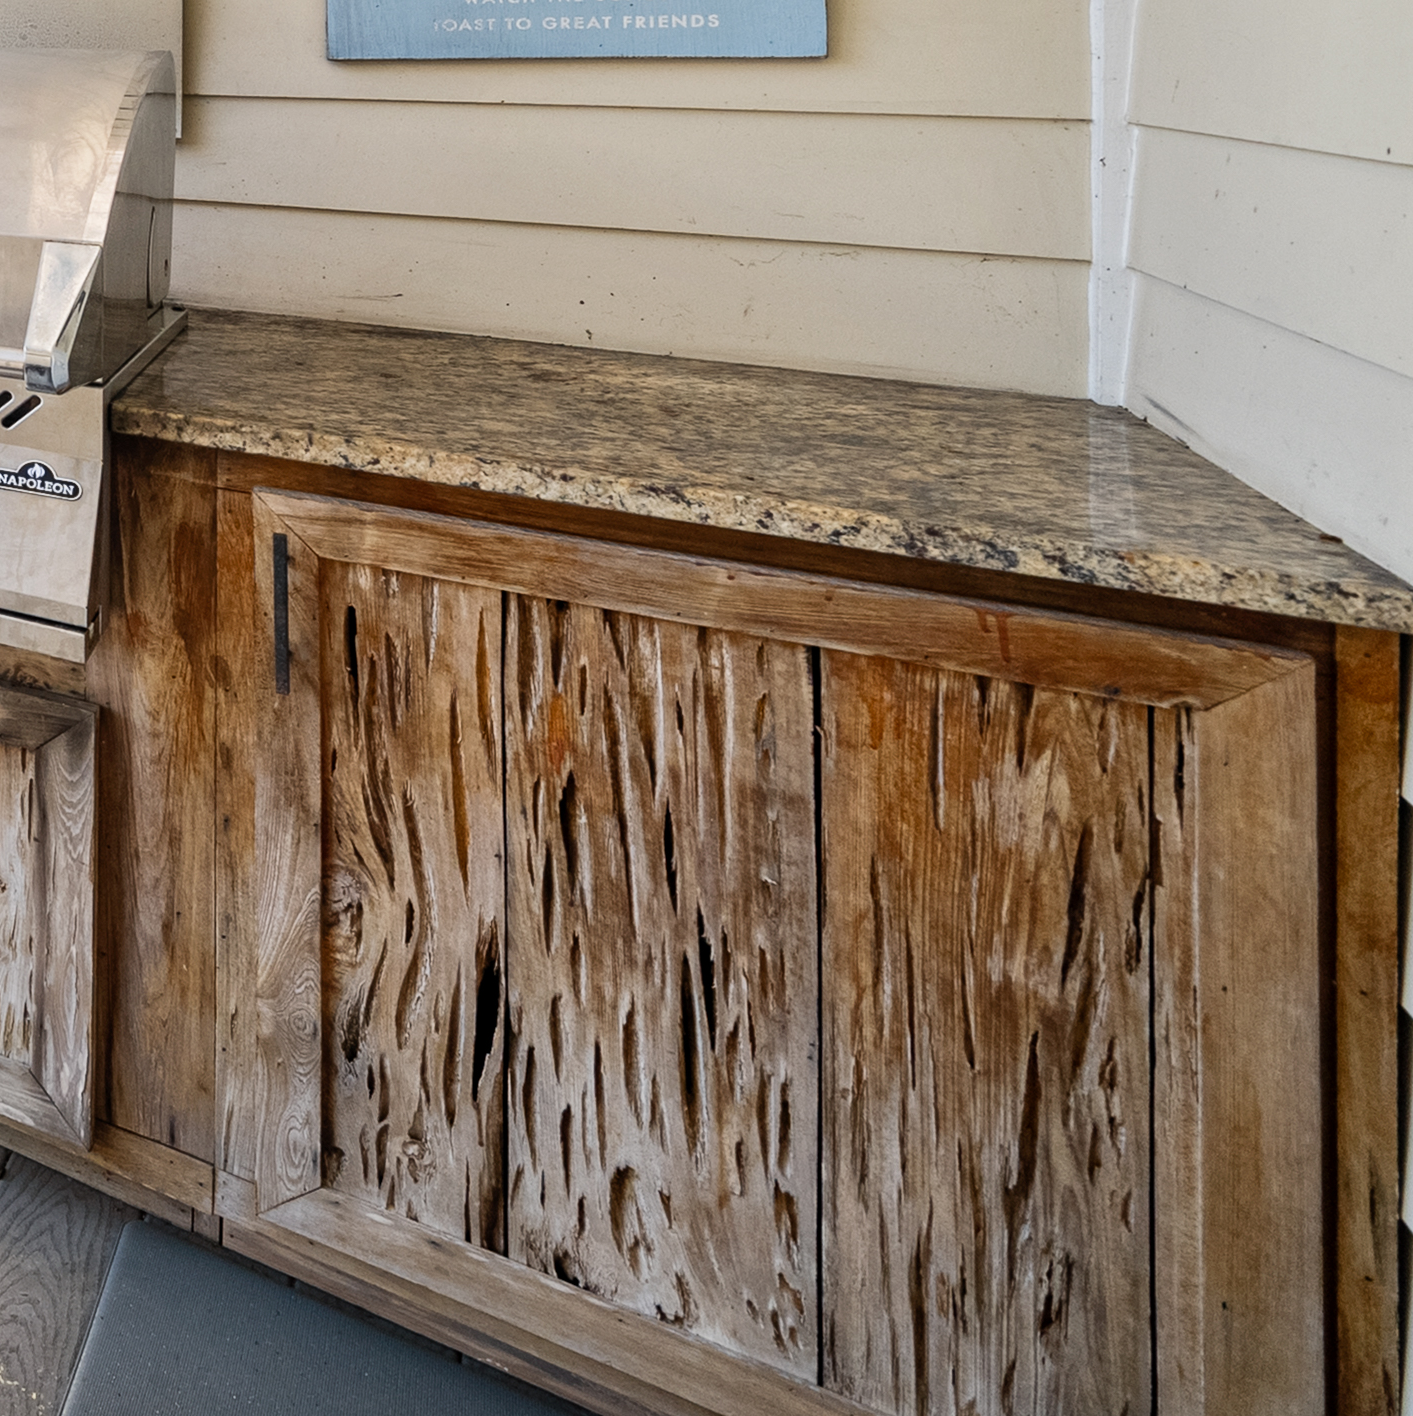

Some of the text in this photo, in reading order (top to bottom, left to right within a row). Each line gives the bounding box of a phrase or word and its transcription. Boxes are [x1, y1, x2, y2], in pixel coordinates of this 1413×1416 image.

[505, 15, 531, 31] TO
[542, 14, 611, 30] GREAT
[622, 12, 720, 29] FRIENDS
